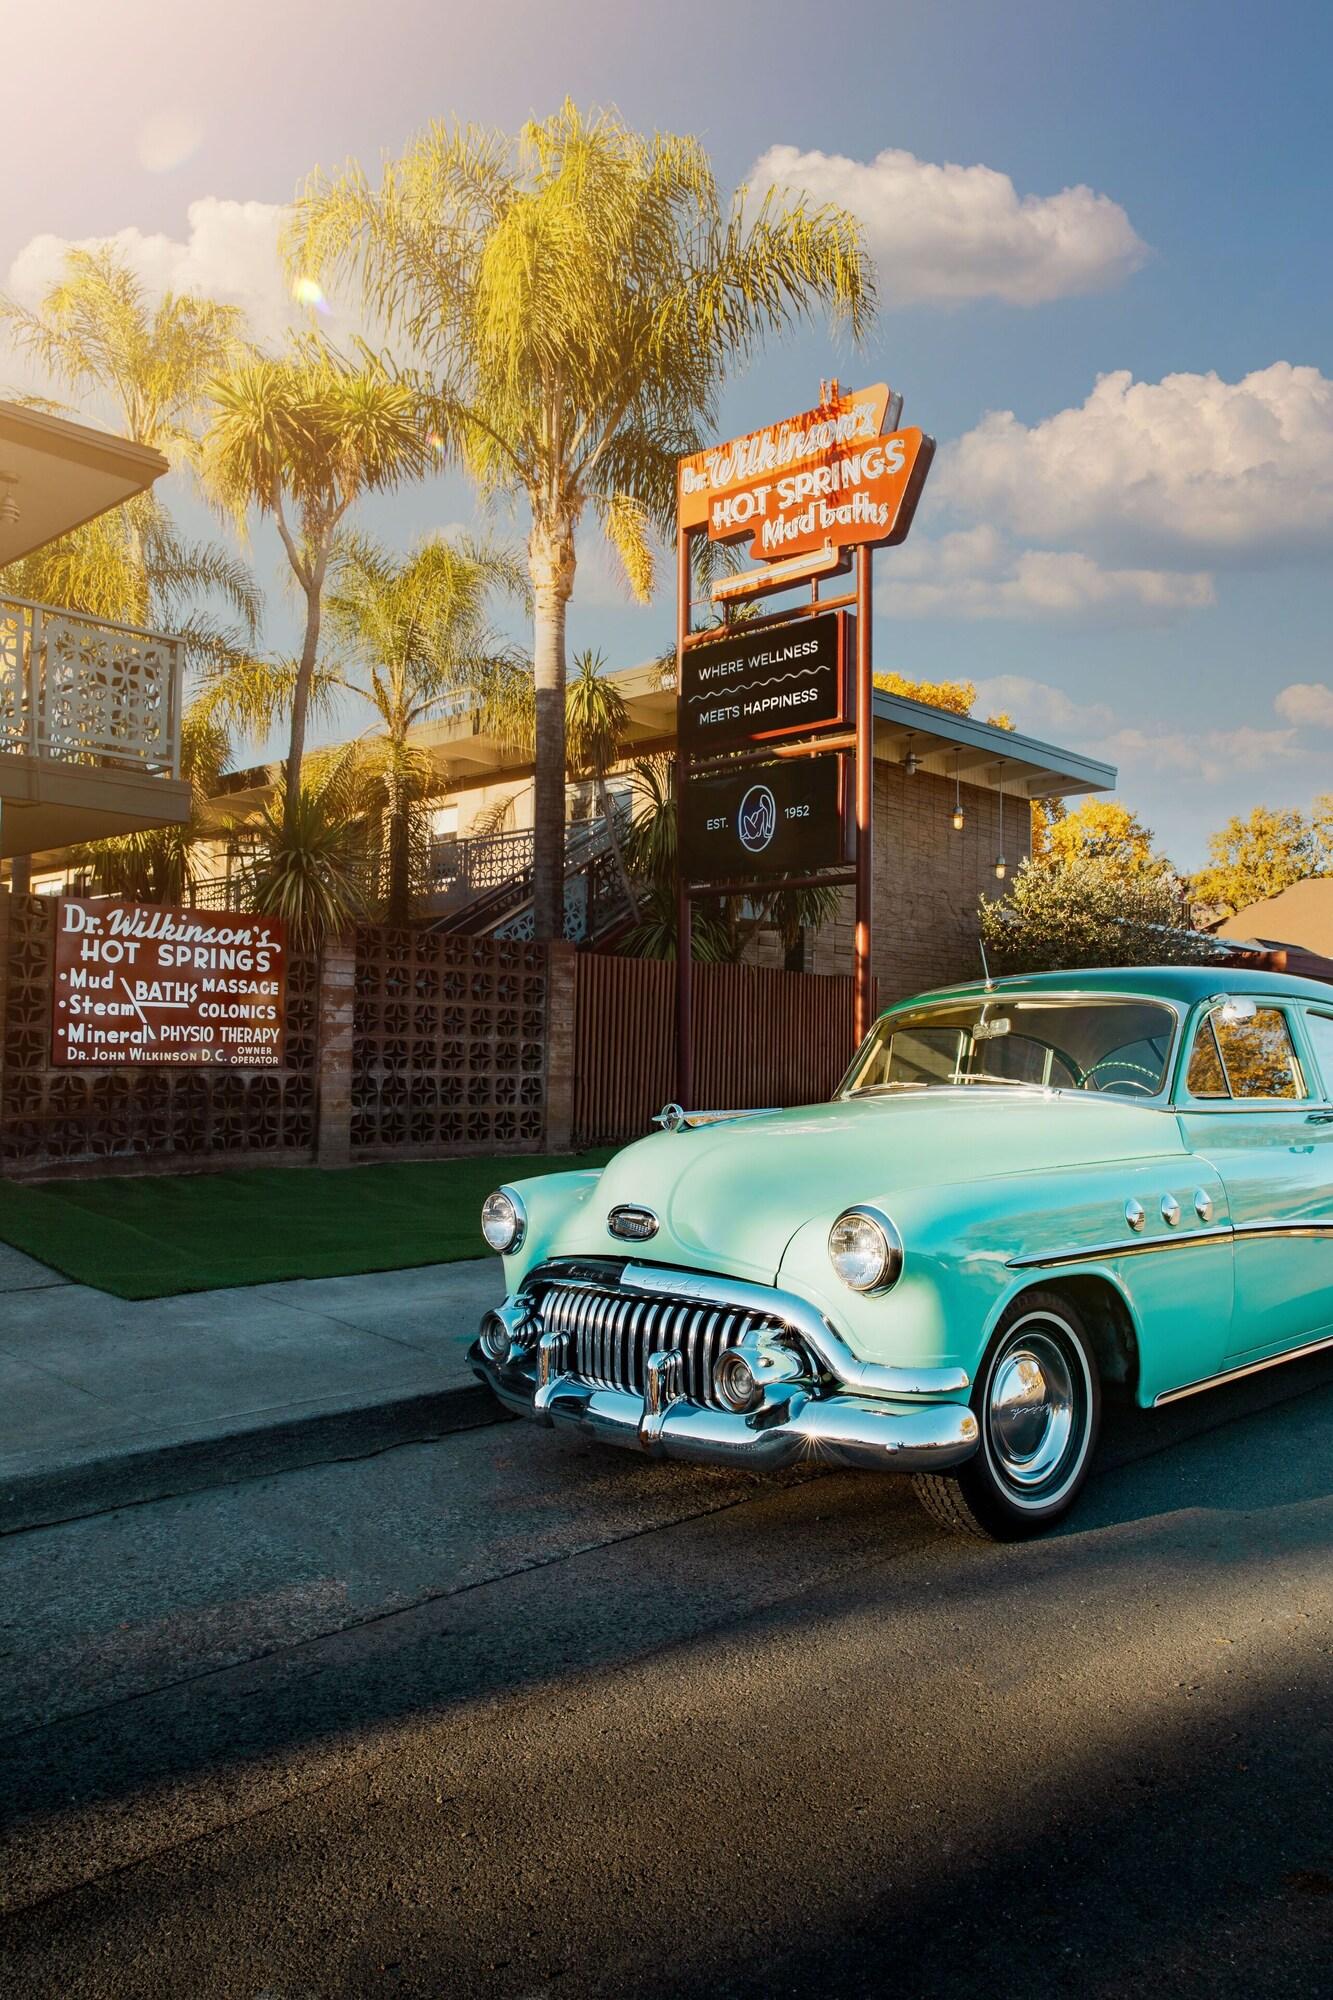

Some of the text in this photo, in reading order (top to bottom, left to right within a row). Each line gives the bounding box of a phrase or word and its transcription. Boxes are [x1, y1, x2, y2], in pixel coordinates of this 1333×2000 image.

[705, 402, 877, 489] Wilkinson's
[711, 439, 906, 531] HOT SPRINGS
[761, 500, 816, 551] Mud
[698, 640, 819, 680] WHERE WELLNESS
[699, 688, 819, 725] MEETS HAPPINESS
[706, 805, 810, 830] EST. 1952
[62, 904, 282, 953] Dr. Wilkinson's
[80, 939, 271, 972] HOT SPRINGS
[70, 968, 114, 989] Mud
[202, 978, 279, 996] MASSAGE
[135, 981, 198, 1003] BATHS
[69, 995, 135, 1016] Steam
[198, 1004, 277, 1020] COLONICS
[68, 1023, 147, 1043] Mineral
[160, 1025, 281, 1044] PHYSIO THERAPY
[230, 1055, 279, 1065] OPERATOR
[237, 1046, 272, 1055] OWNER
